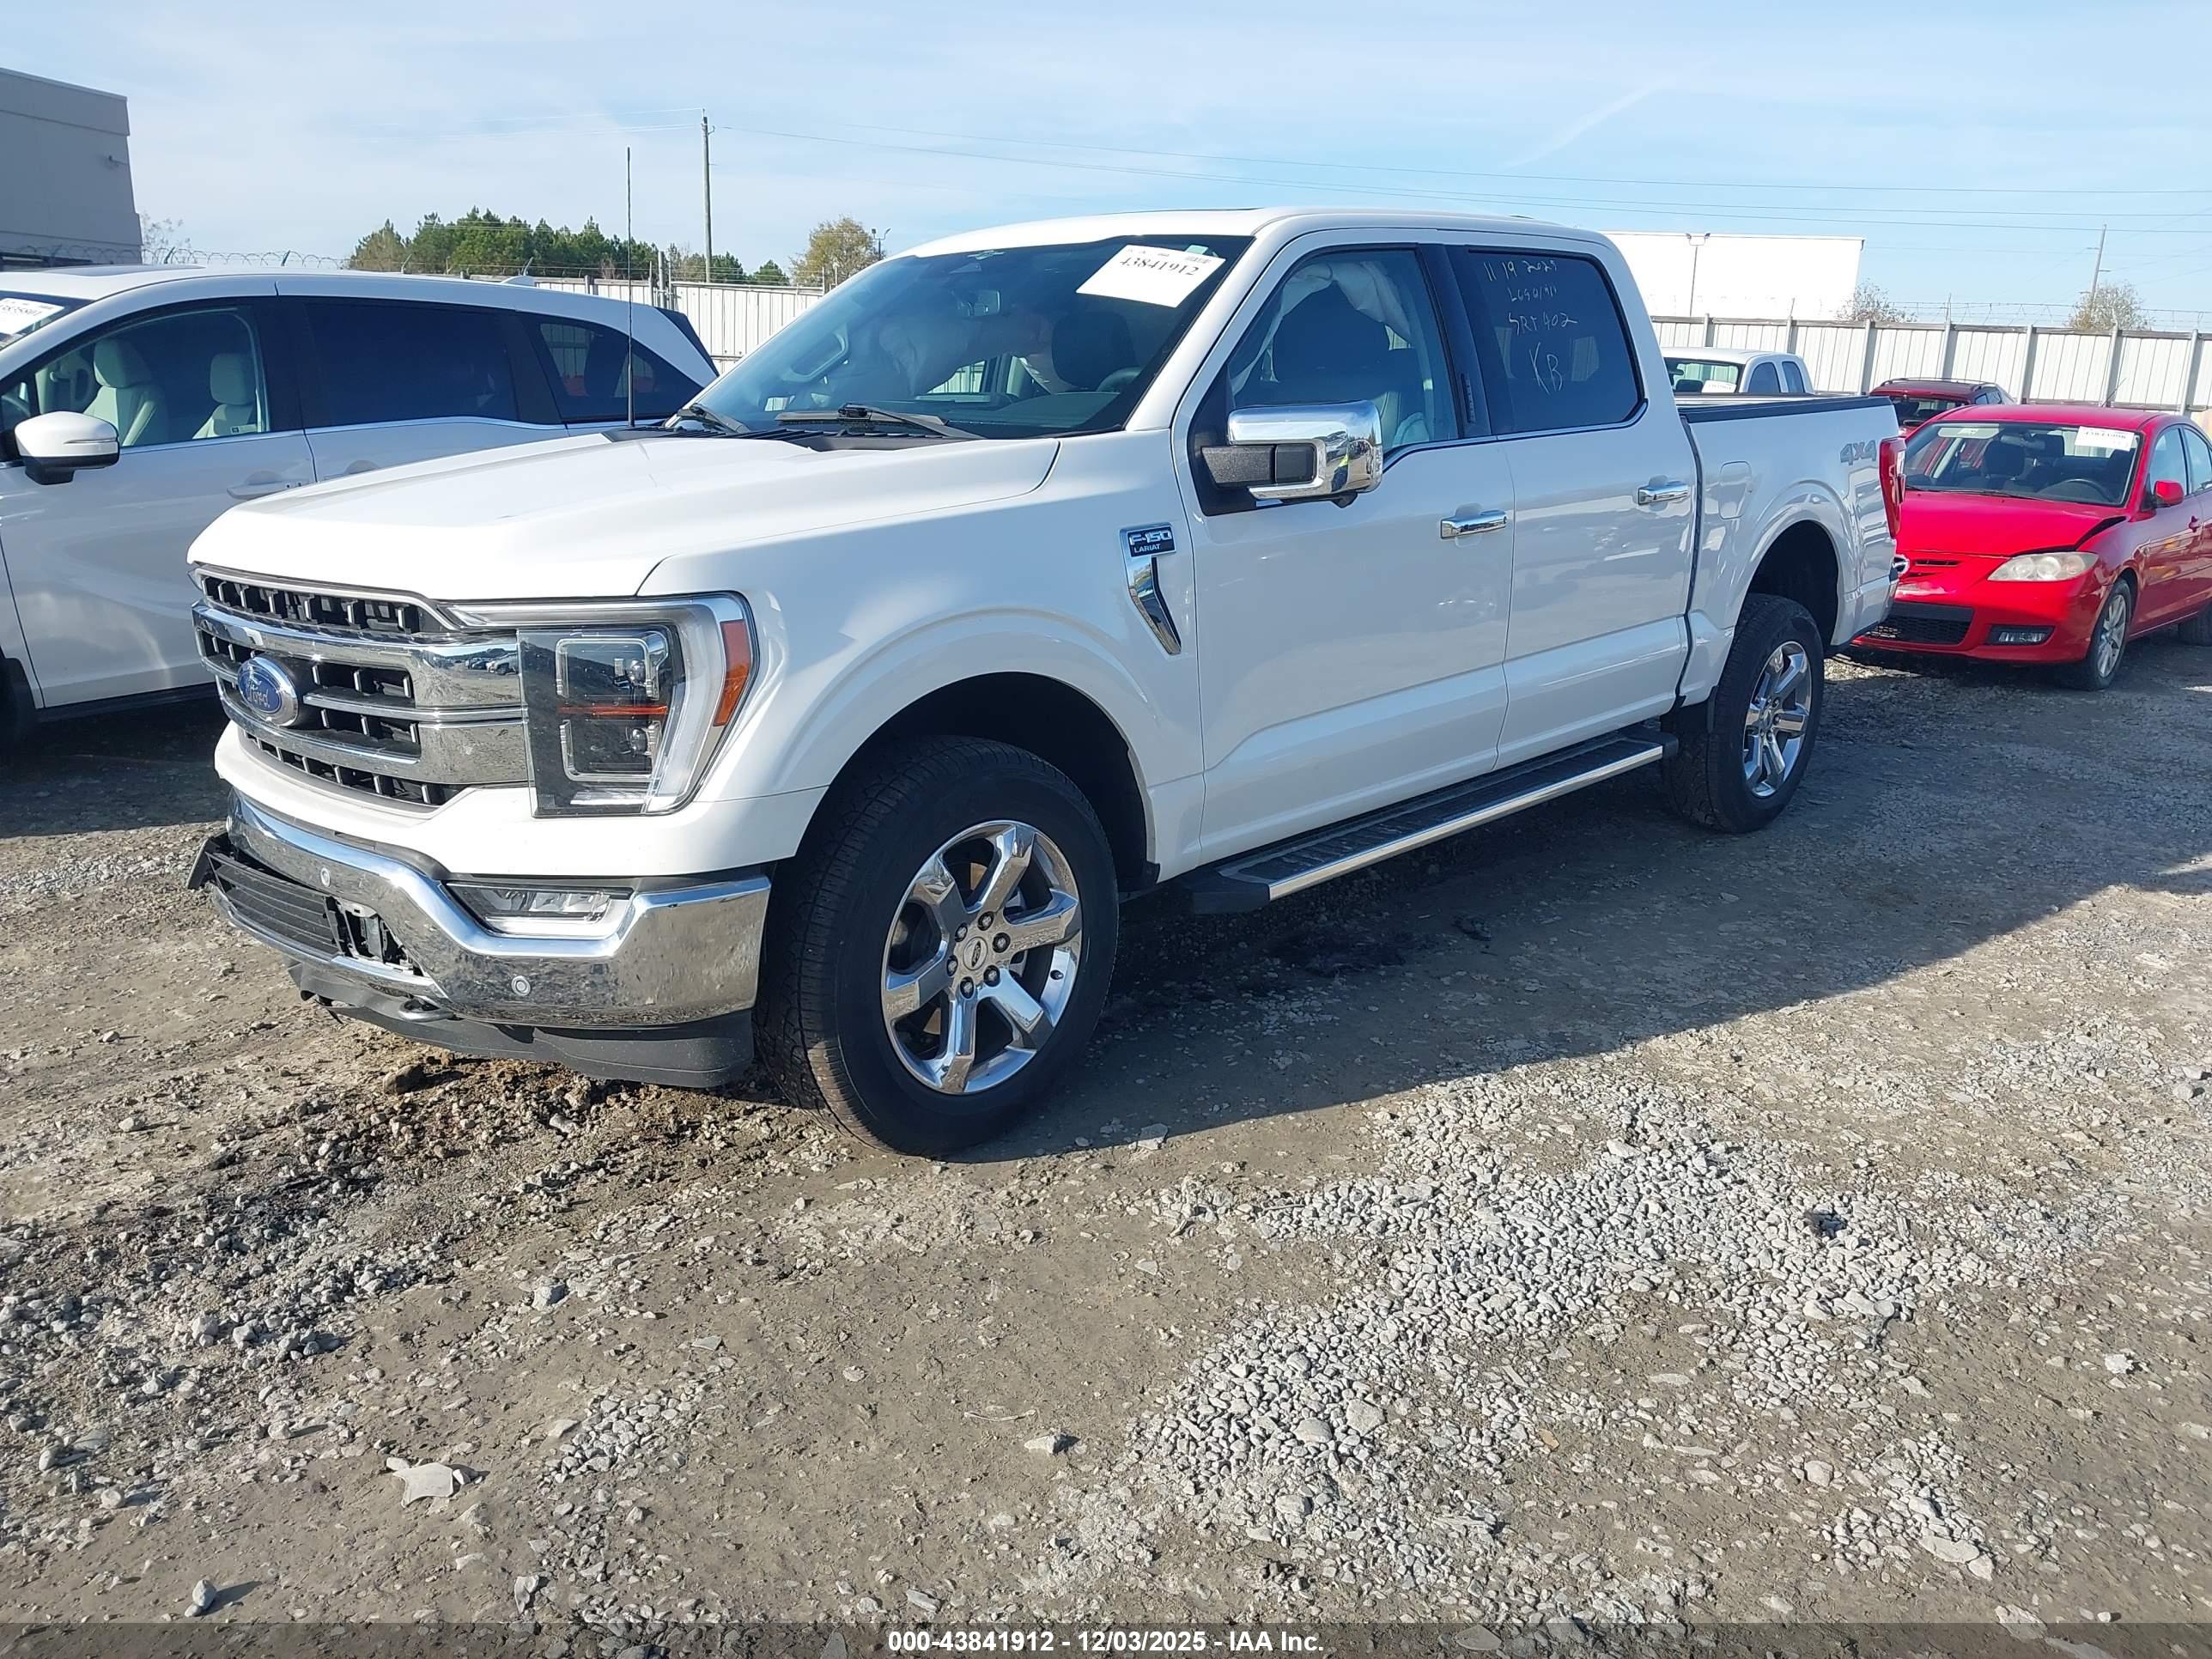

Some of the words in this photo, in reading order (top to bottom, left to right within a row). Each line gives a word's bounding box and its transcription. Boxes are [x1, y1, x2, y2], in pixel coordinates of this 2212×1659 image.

[1120, 257, 1200, 276] 43841912
[1483, 261, 1497, 282] 11
[1502, 261, 1518, 280] 19
[1129, 530, 1173, 545] F-150
[1134, 544, 1161, 553] LARIAT
[246, 675, 271, 708] Ford
